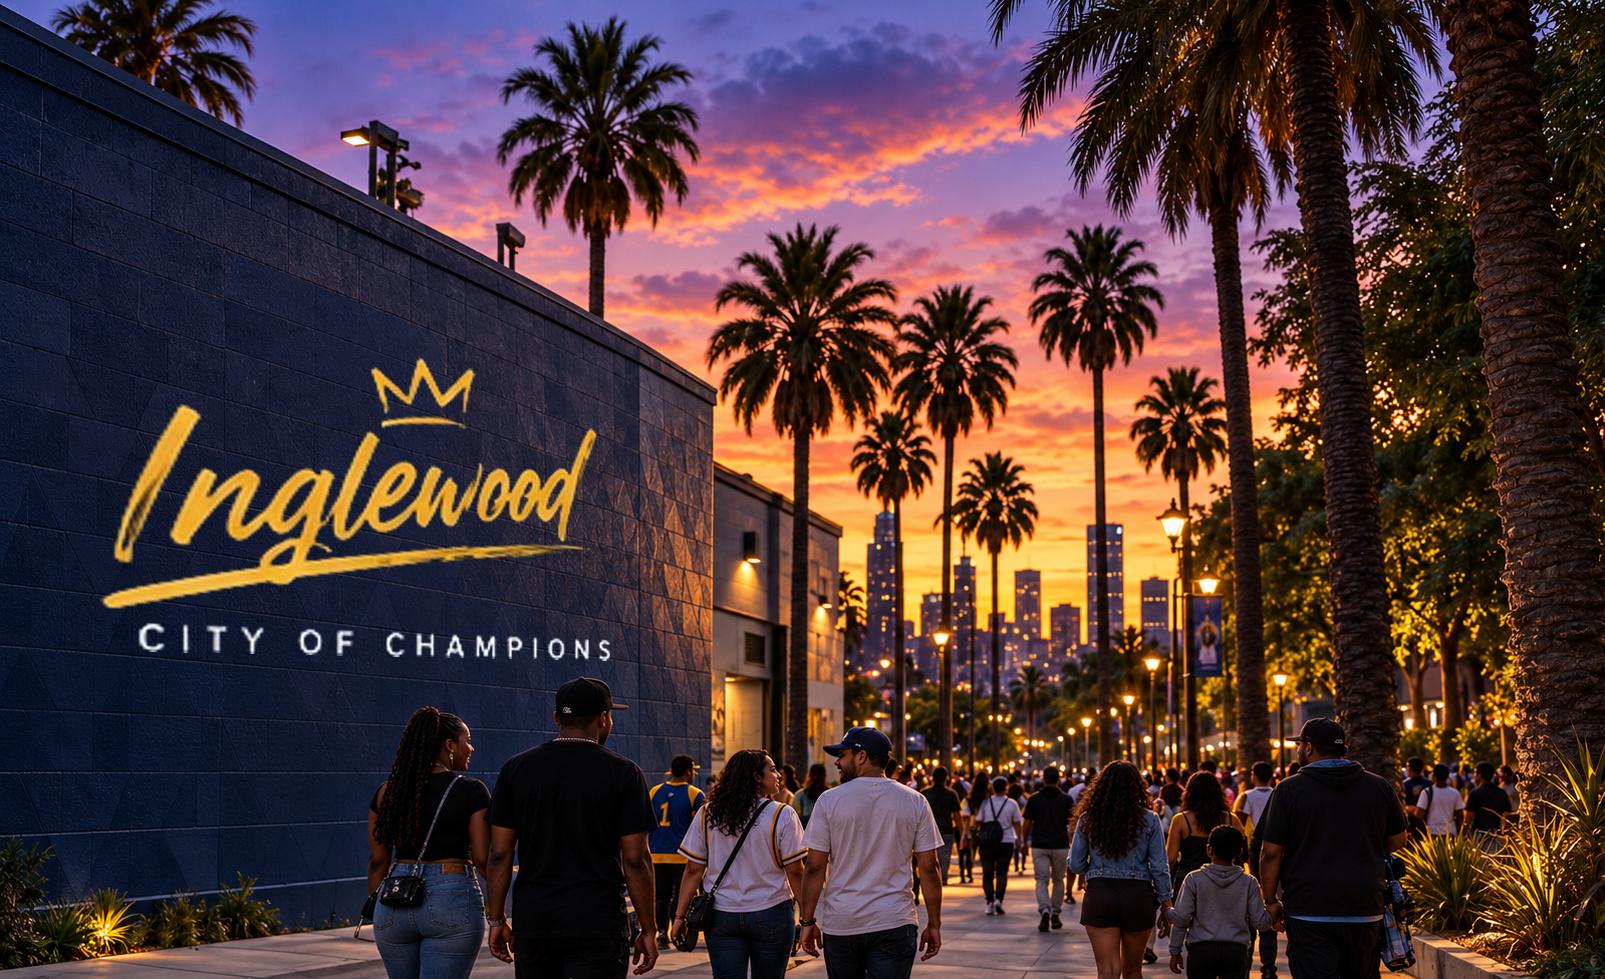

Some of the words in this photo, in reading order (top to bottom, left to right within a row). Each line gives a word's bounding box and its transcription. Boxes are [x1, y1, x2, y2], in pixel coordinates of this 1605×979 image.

[115, 404, 597, 585] Inglewood
[138, 623, 264, 655] CITY
[299, 628, 354, 656] OF
[386, 631, 612, 662] CHAMPIONS
[659, 802, 671, 827] 1
